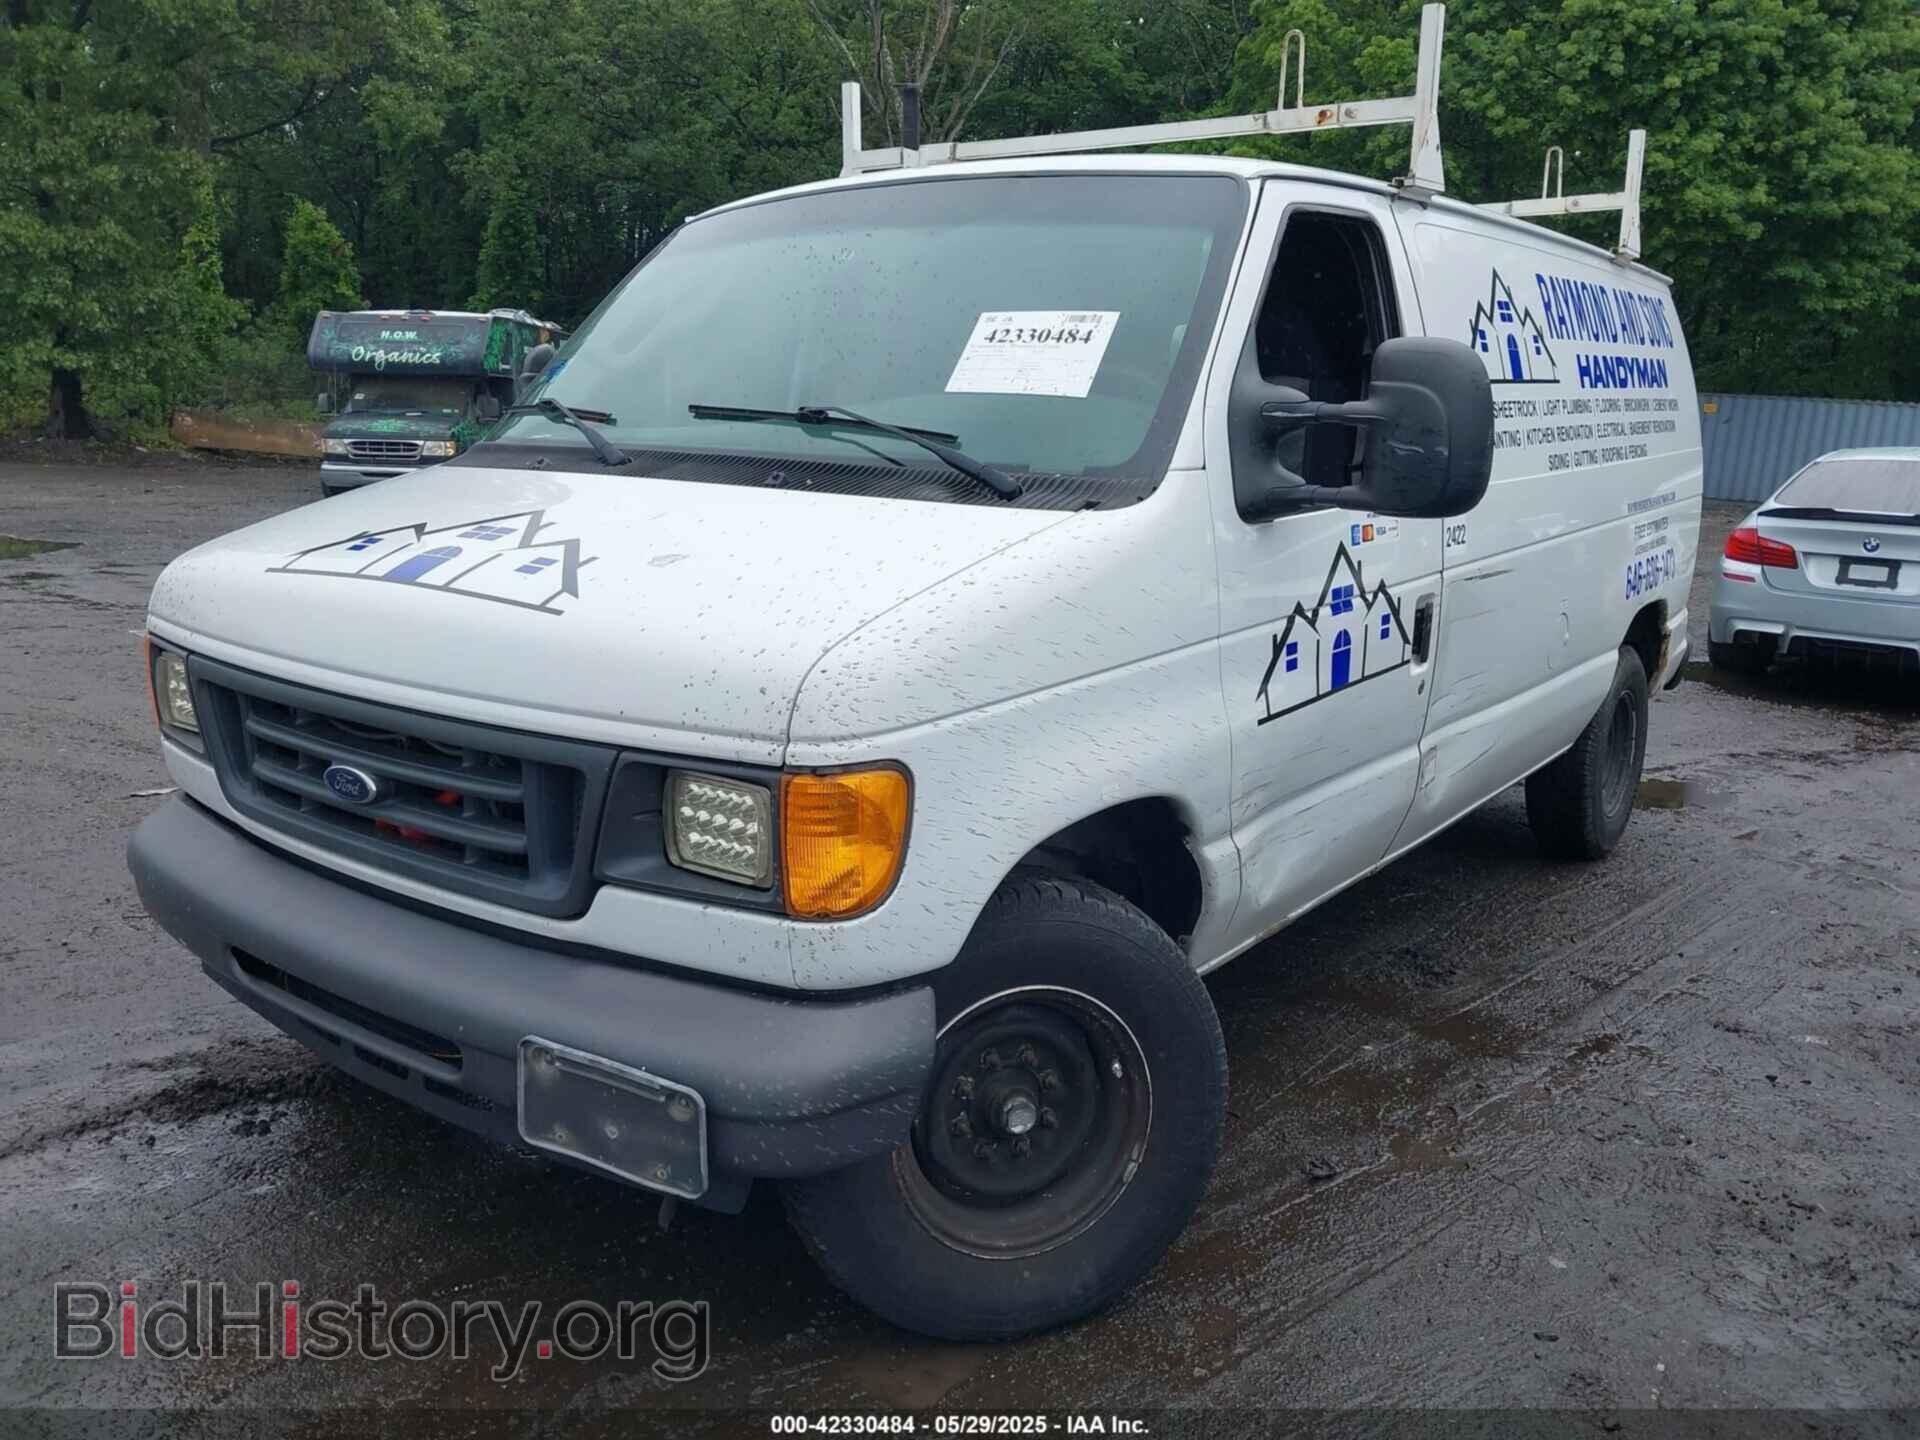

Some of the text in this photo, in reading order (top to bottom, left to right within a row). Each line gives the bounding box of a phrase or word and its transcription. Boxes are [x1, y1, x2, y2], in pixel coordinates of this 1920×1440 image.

[1536, 273, 1674, 348] RAYMOND AND SONS
[984, 328, 1094, 344] 42330484
[352, 346, 441, 371] Organics
[1576, 354, 1668, 388] HANDYMAN
[1493, 400, 1539, 418] SHEETROCK
[1542, 399, 1561, 416] LIGHT
[1527, 427, 1555, 447] KITCHEN
[1556, 425, 1593, 442] RENOVATION
[1597, 422, 1626, 438] ELECTRICAL
[1548, 453, 1570, 472] SIDING
[1574, 449, 1598, 468] GUTTING
[1446, 524, 1466, 547] 2422
[334, 773, 360, 795] Ford
